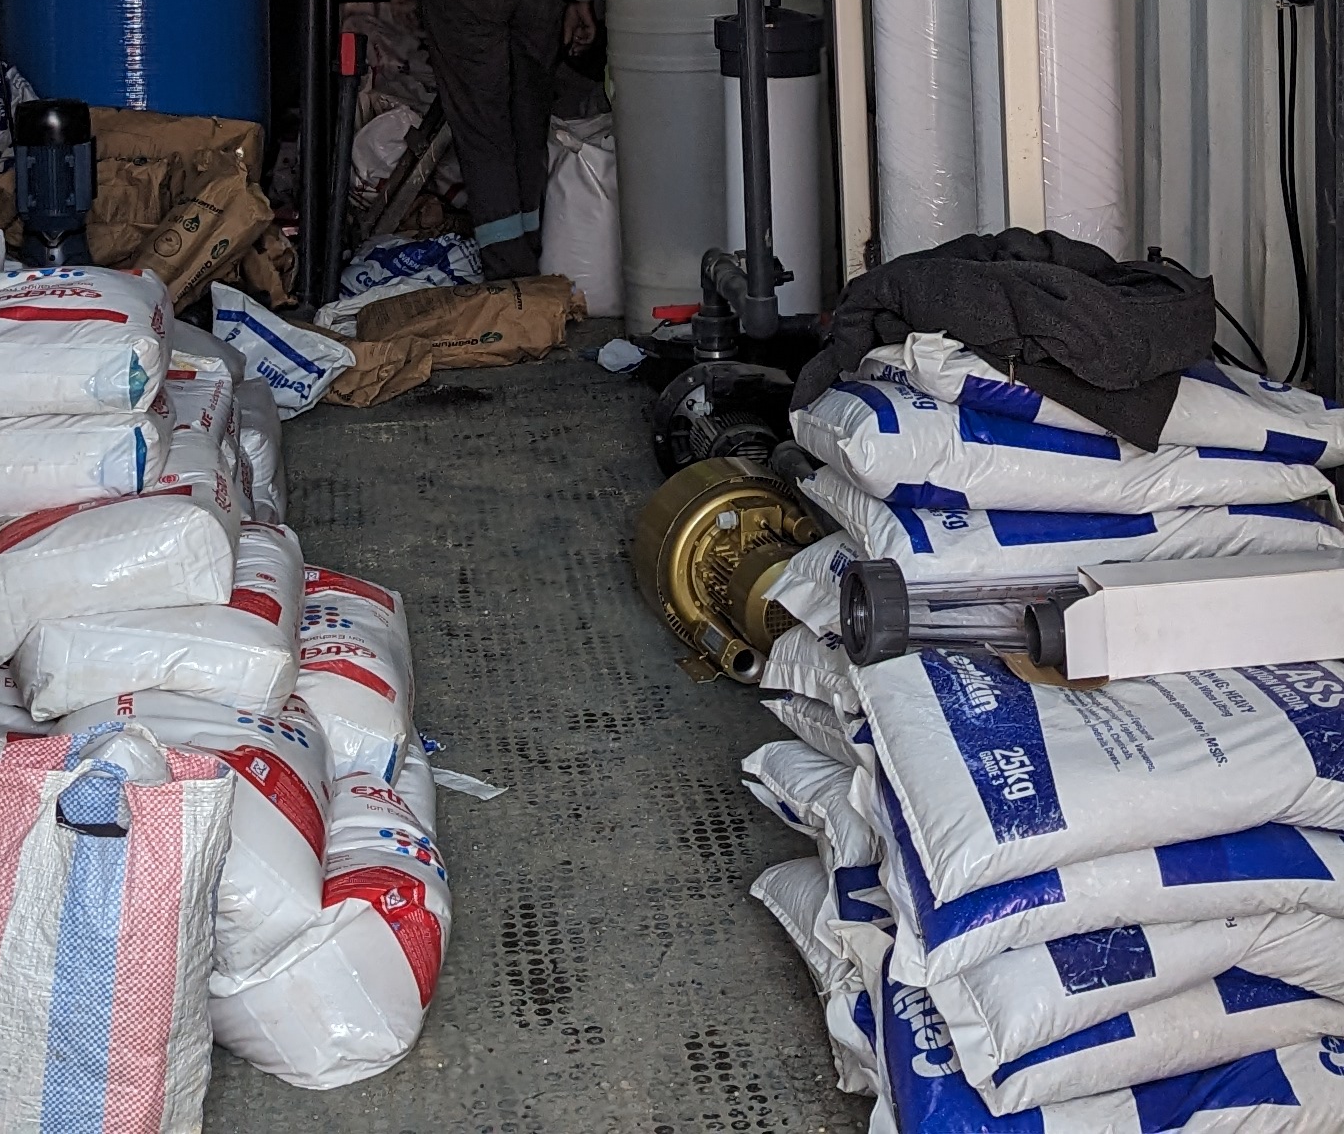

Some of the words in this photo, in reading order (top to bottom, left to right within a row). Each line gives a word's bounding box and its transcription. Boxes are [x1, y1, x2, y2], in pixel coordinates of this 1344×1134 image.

[432, 338, 479, 348] Quantum
[1222, 688, 1256, 714] HEAVY
[978, 750, 1000, 778] GRADE
[991, 775, 1005, 786] 3
[991, 746, 1037, 801] 25kg
